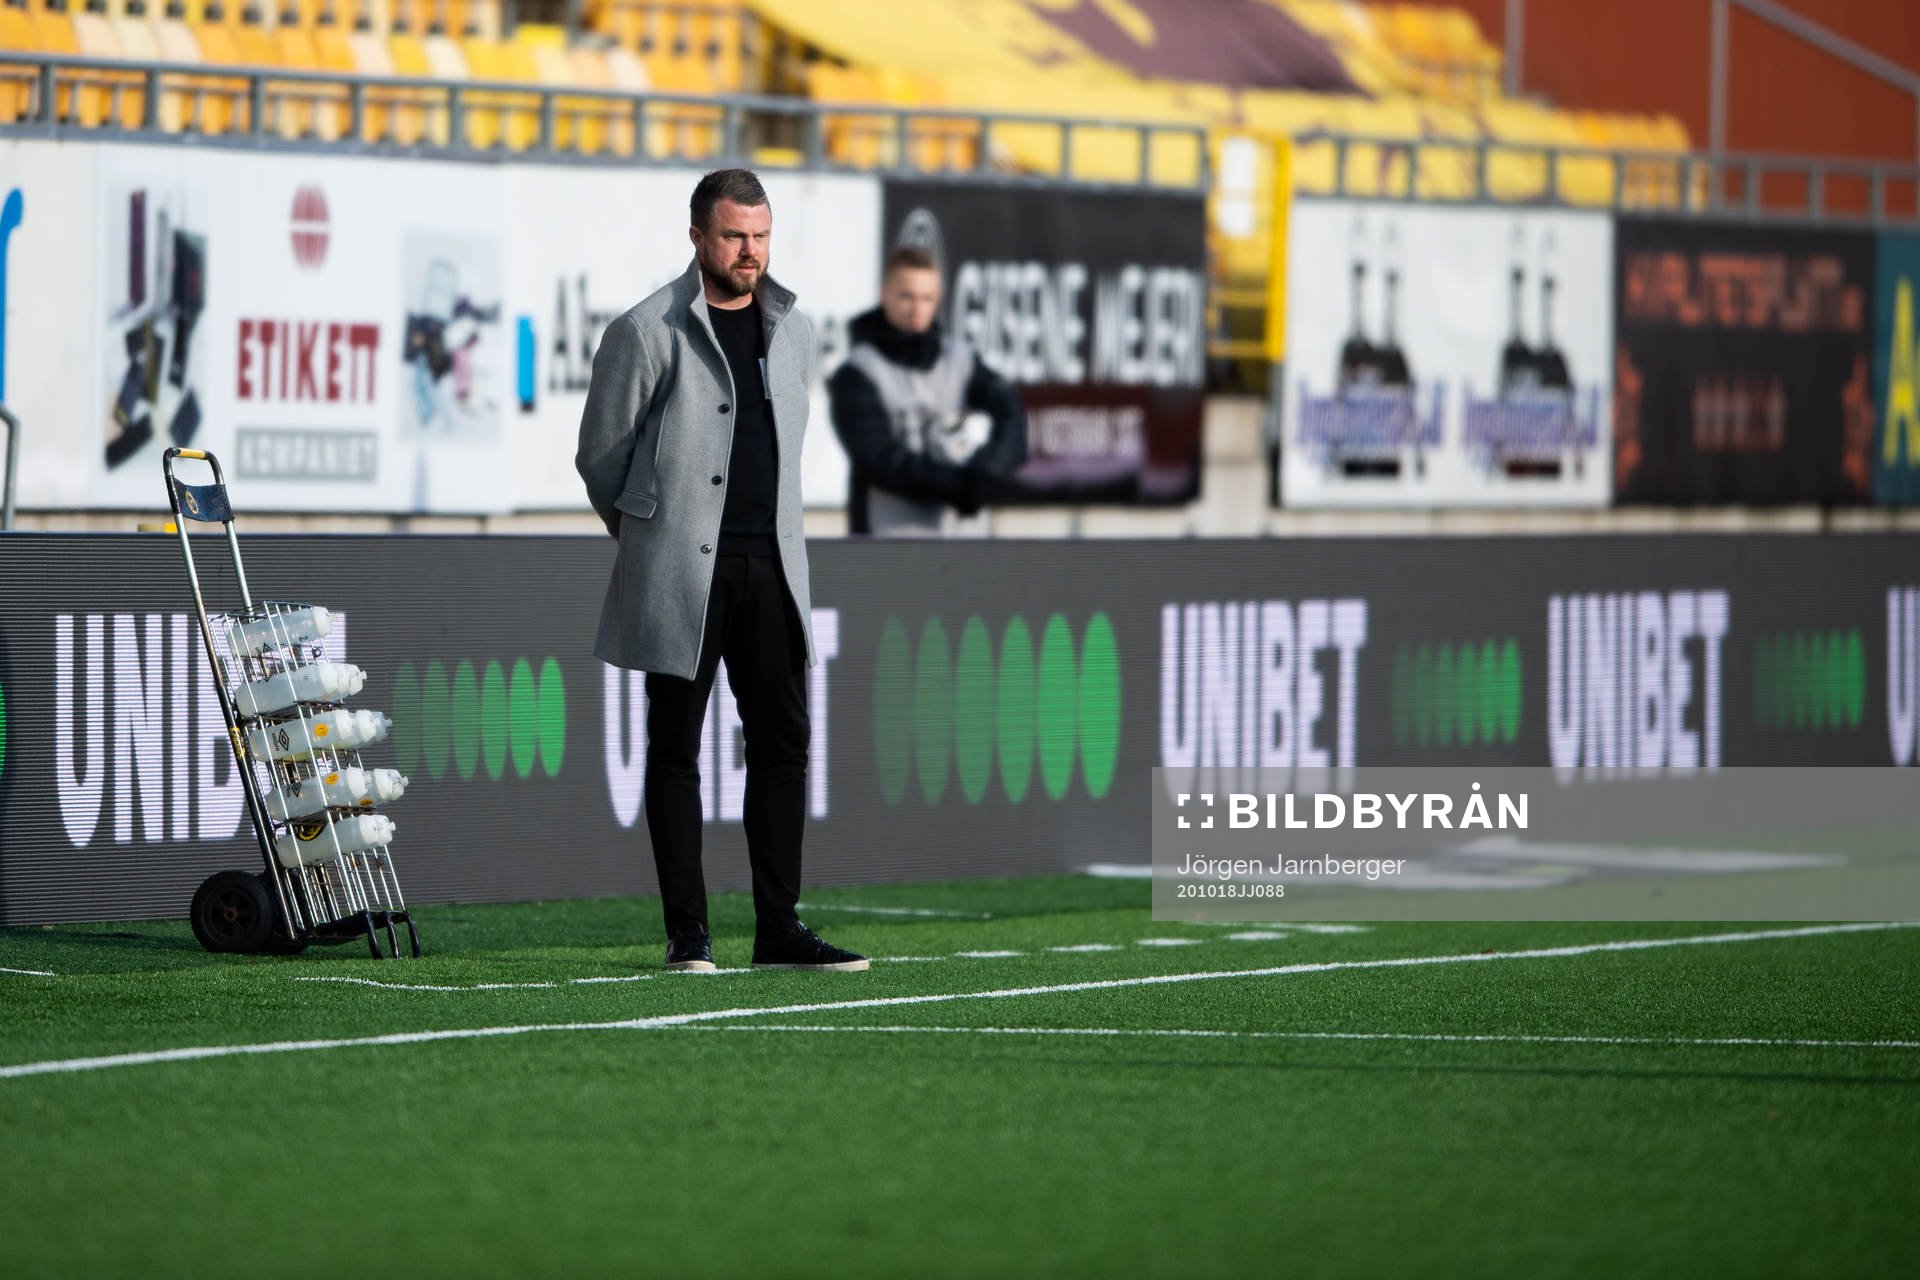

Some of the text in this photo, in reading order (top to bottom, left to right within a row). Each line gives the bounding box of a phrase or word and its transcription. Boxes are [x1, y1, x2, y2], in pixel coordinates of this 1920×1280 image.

[237, 320, 380, 402] ETIKETT
[1160, 600, 1367, 806] UNIBET
[1547, 591, 1729, 785] UNIBET
